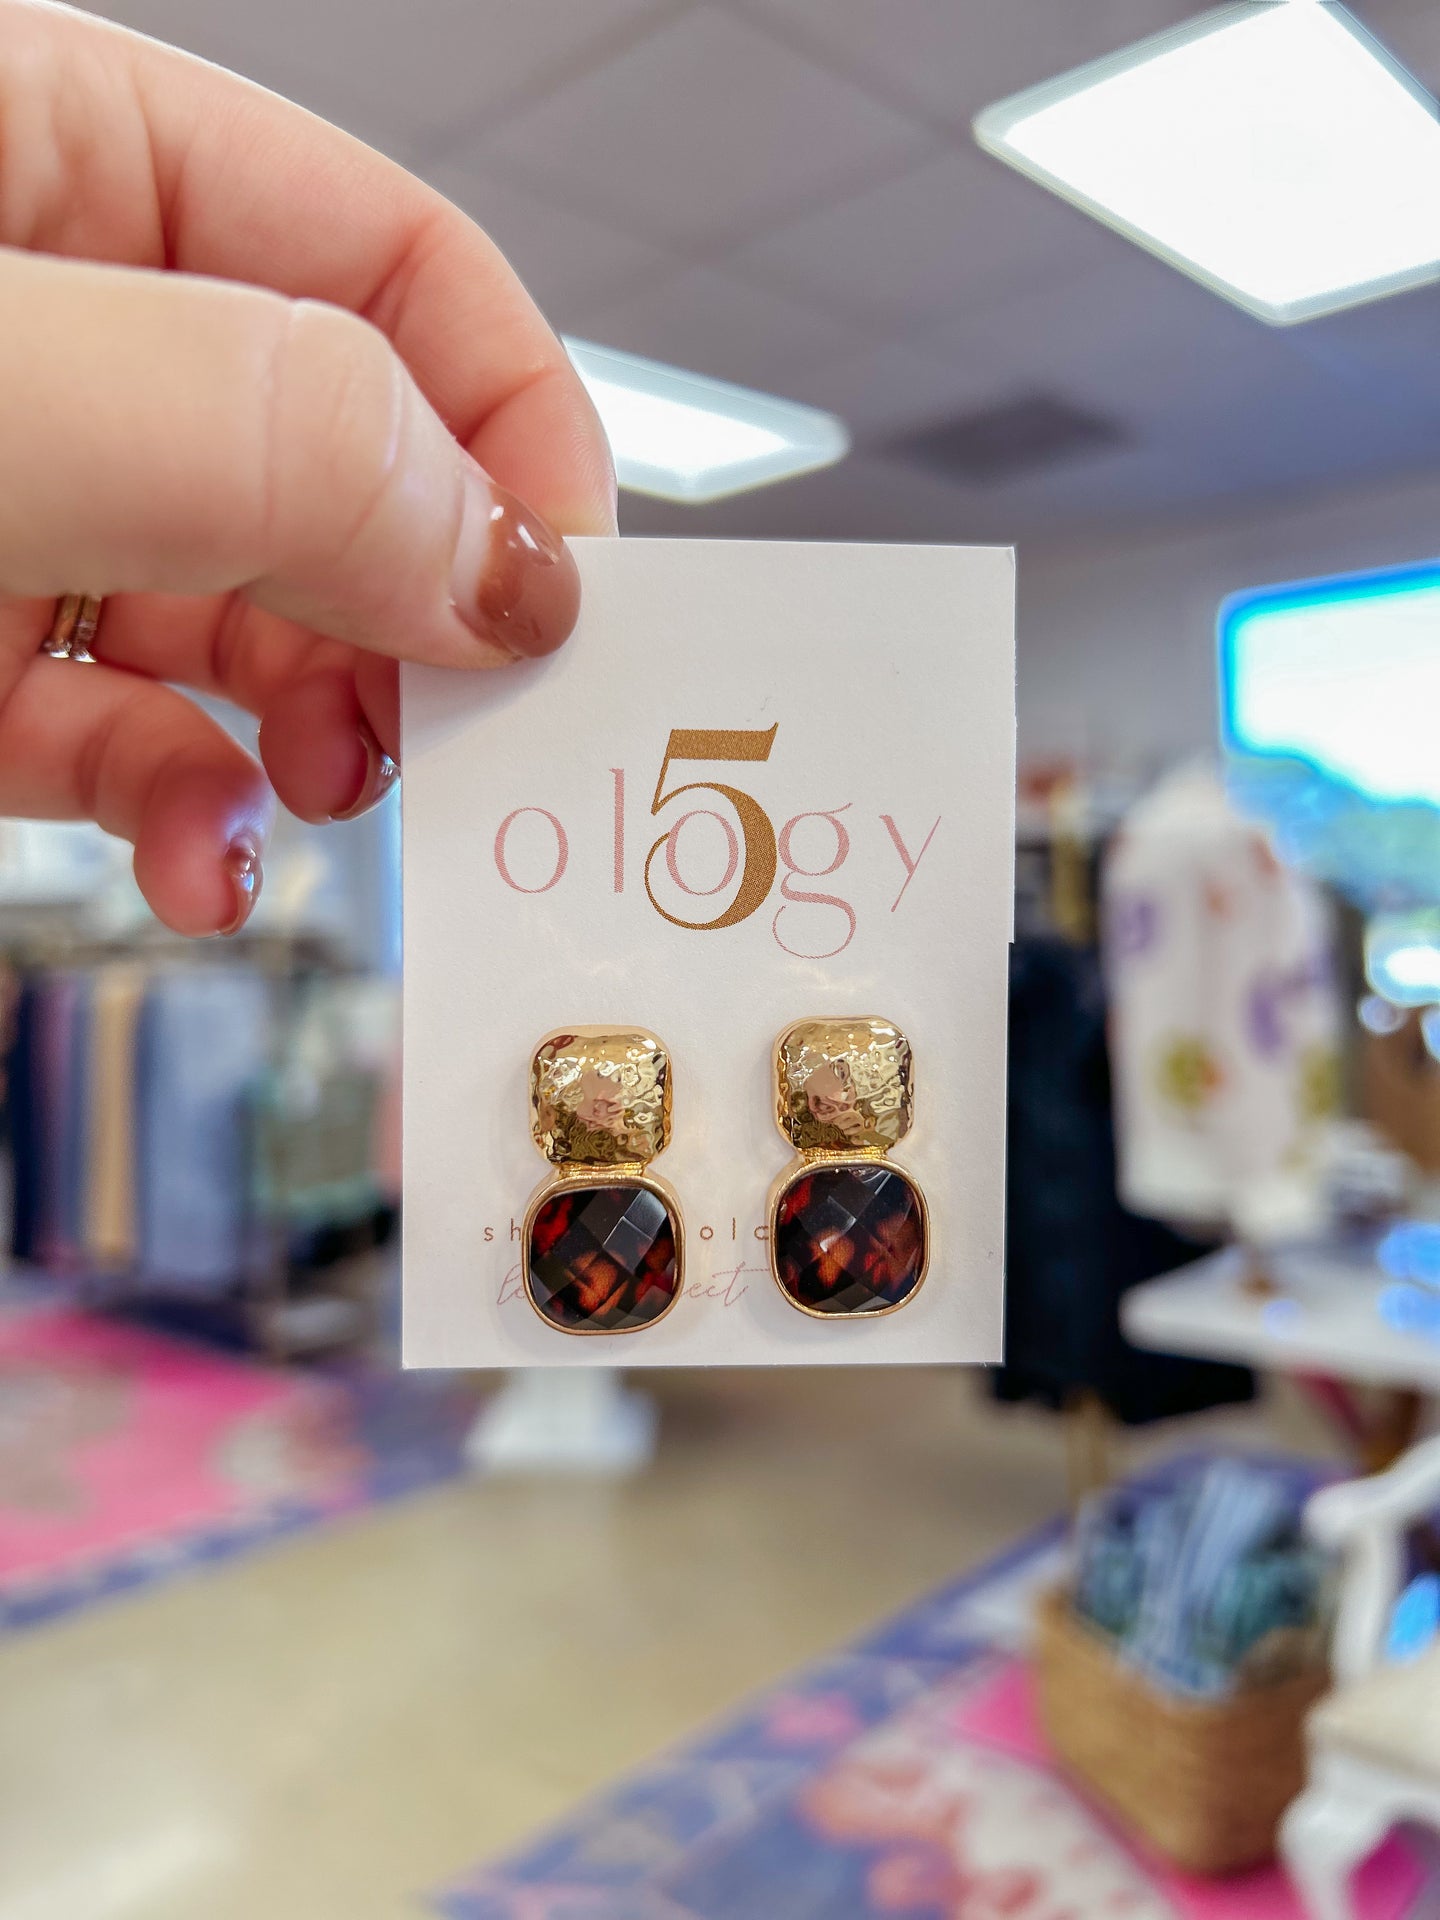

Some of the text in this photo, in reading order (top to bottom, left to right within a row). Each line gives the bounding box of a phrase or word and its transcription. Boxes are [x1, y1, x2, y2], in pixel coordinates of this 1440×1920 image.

[494, 767, 942, 959] ology
[645, 721, 779, 931] 5
[682, 1261, 770, 1307] ect
